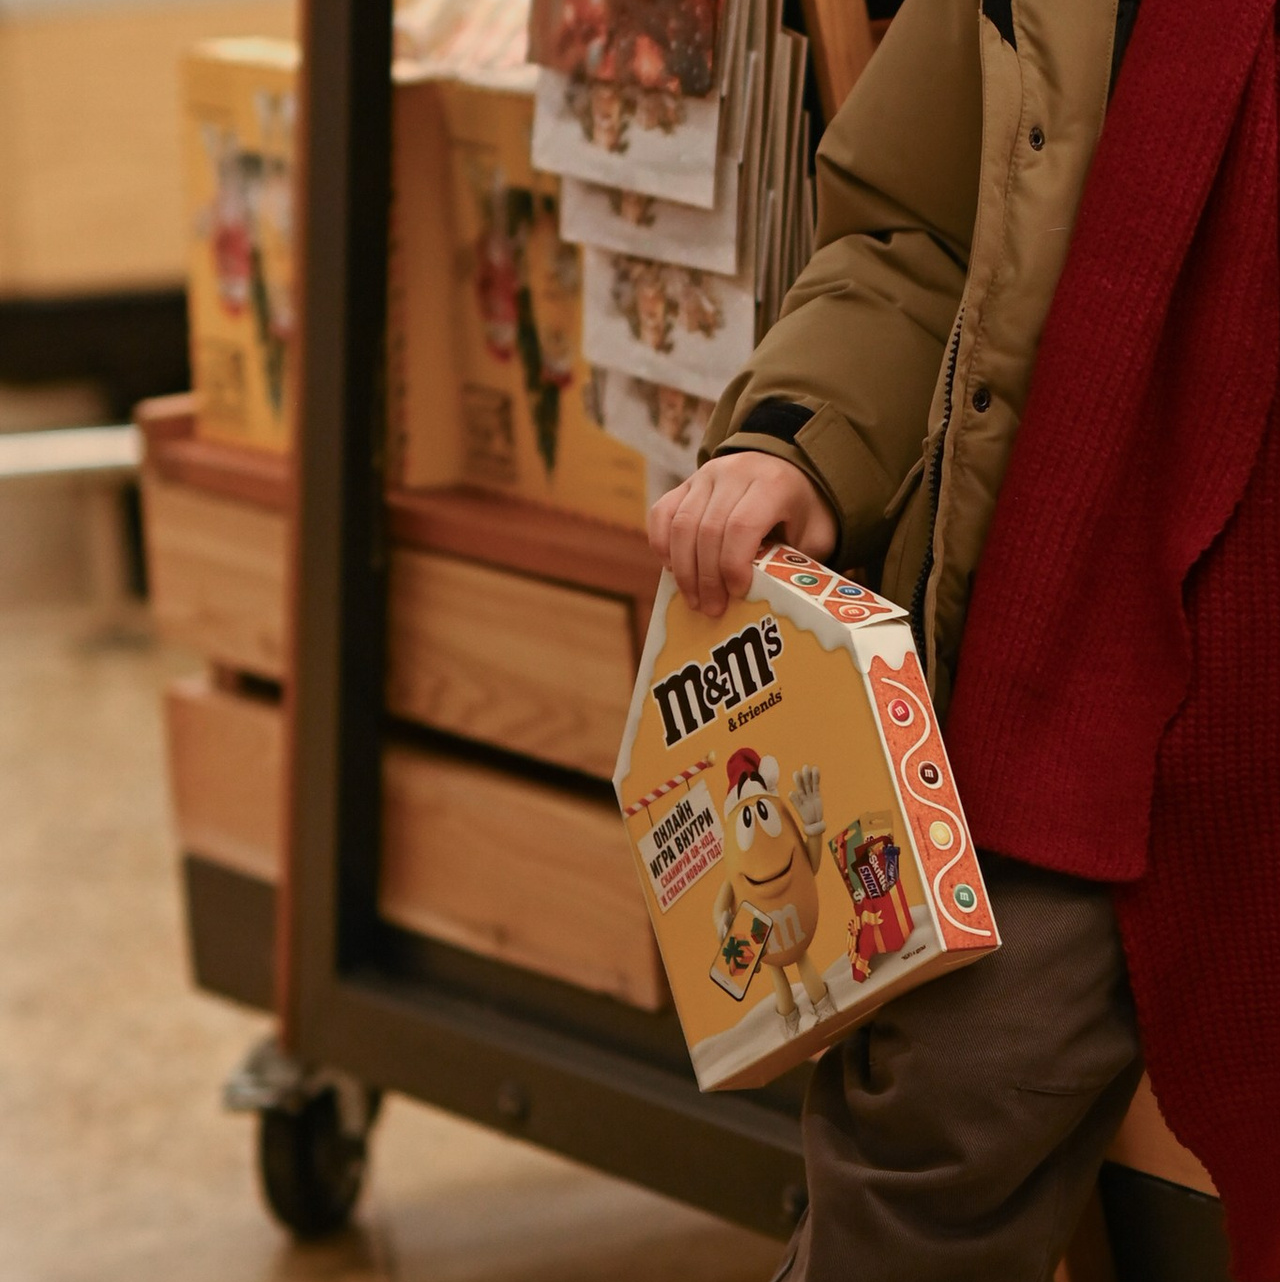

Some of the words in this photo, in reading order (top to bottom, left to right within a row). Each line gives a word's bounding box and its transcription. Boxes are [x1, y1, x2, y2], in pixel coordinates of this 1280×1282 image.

[728, 718, 738, 732] &
[738, 691, 782, 728] friends
[649, 845, 677, 879] ИГРА
[674, 807, 714, 855] ВНУТРИ
[653, 799, 694, 850] ОНЛАЙН
[660, 851, 692, 888] СКАНИРУЙ
[690, 831, 716, 858] QR-КОД
[665, 878, 687, 902] СПАСИ
[685, 855, 708, 883] НОВЫЙ
[706, 843, 723, 865] ГОД!
[868, 854, 888, 891] Skittle
